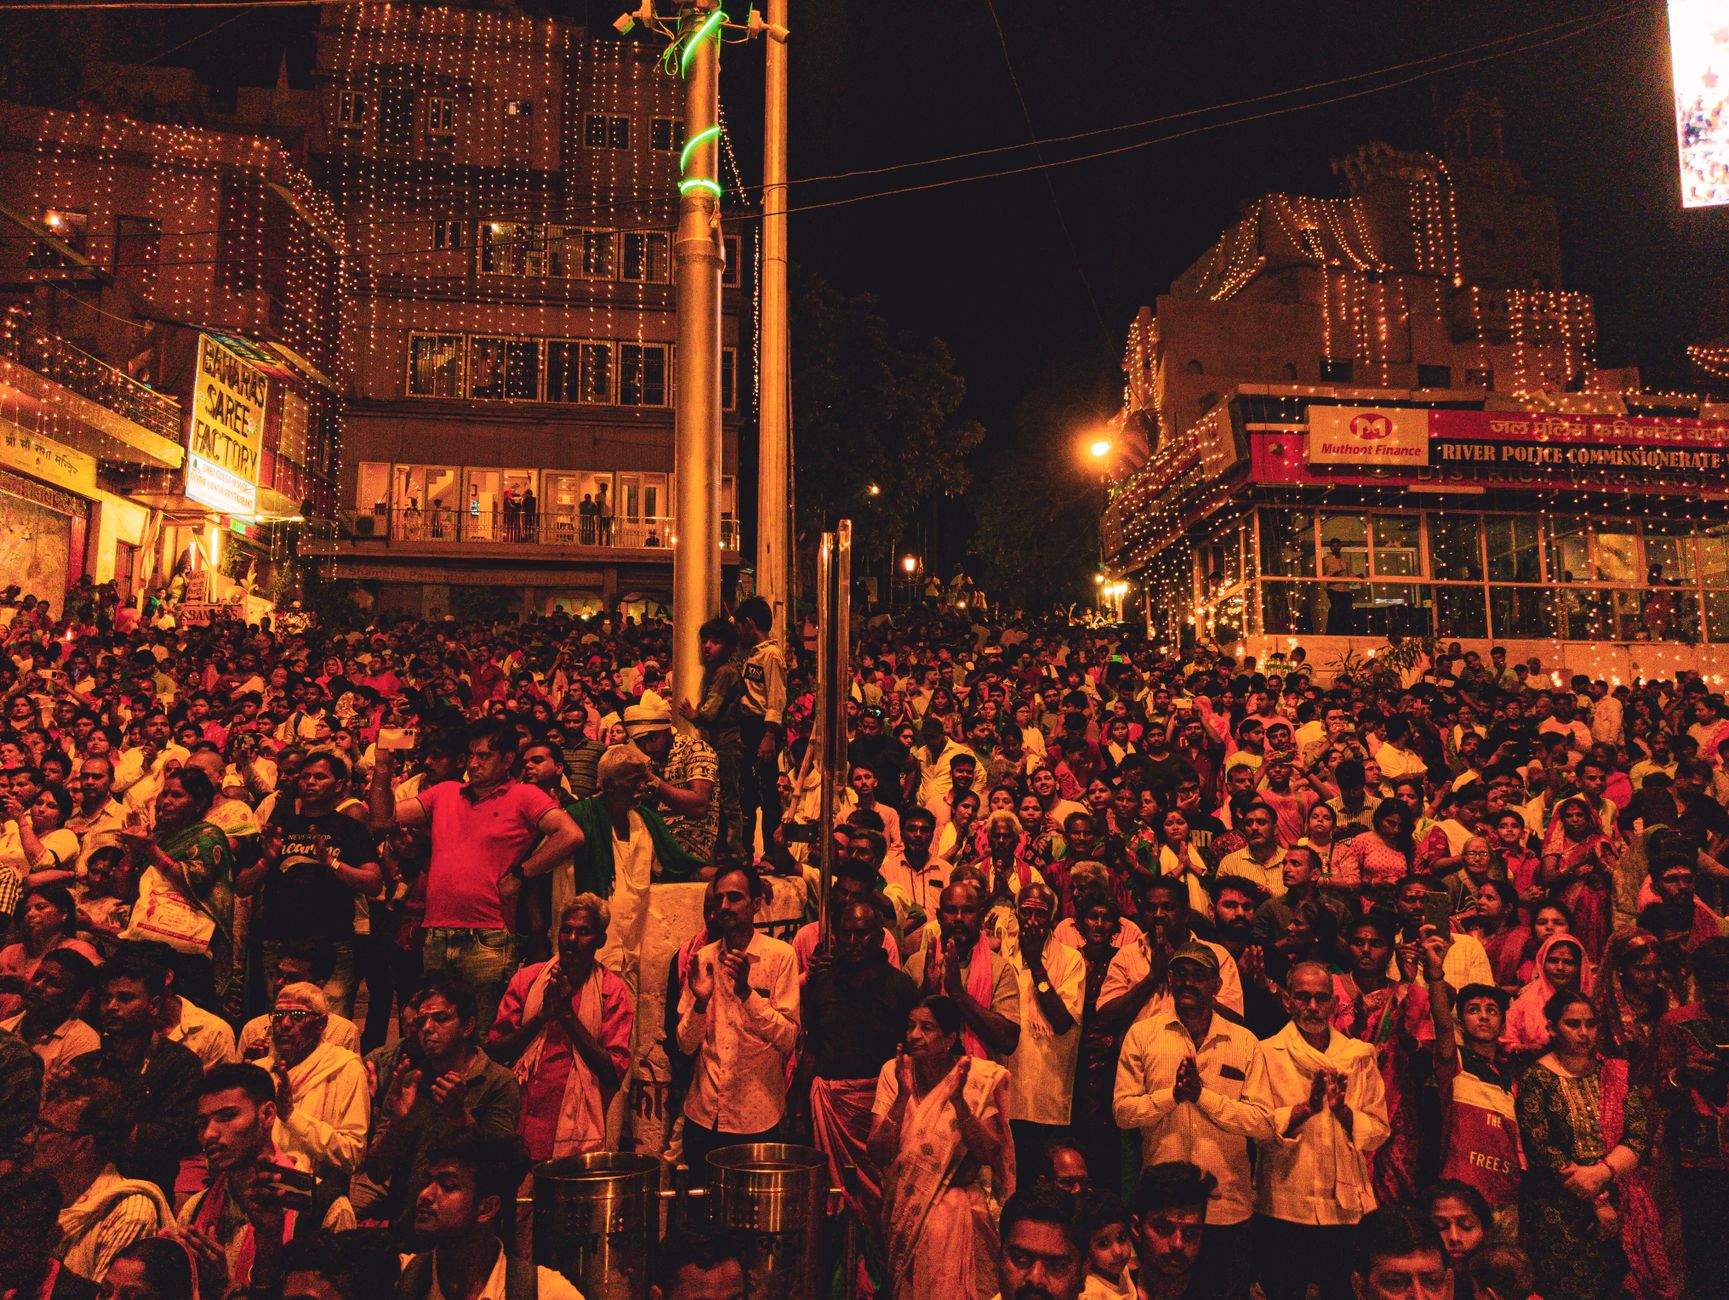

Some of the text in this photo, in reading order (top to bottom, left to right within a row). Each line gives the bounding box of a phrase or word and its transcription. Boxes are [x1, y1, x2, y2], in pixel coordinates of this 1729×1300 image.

[205, 383, 250, 438] SAREE
[1489, 420, 1530, 436] जल
[192, 418, 258, 480] FACTORY
[1322, 443, 1422, 457] Muthoot Finance
[1442, 444, 1496, 461] RIVER
[1502, 446, 1563, 463] POLICE
[1567, 447, 1721, 469] COMMISSIONERATE
[1486, 1113, 1502, 1128] THE
[1469, 1151, 1501, 1172] FREE
